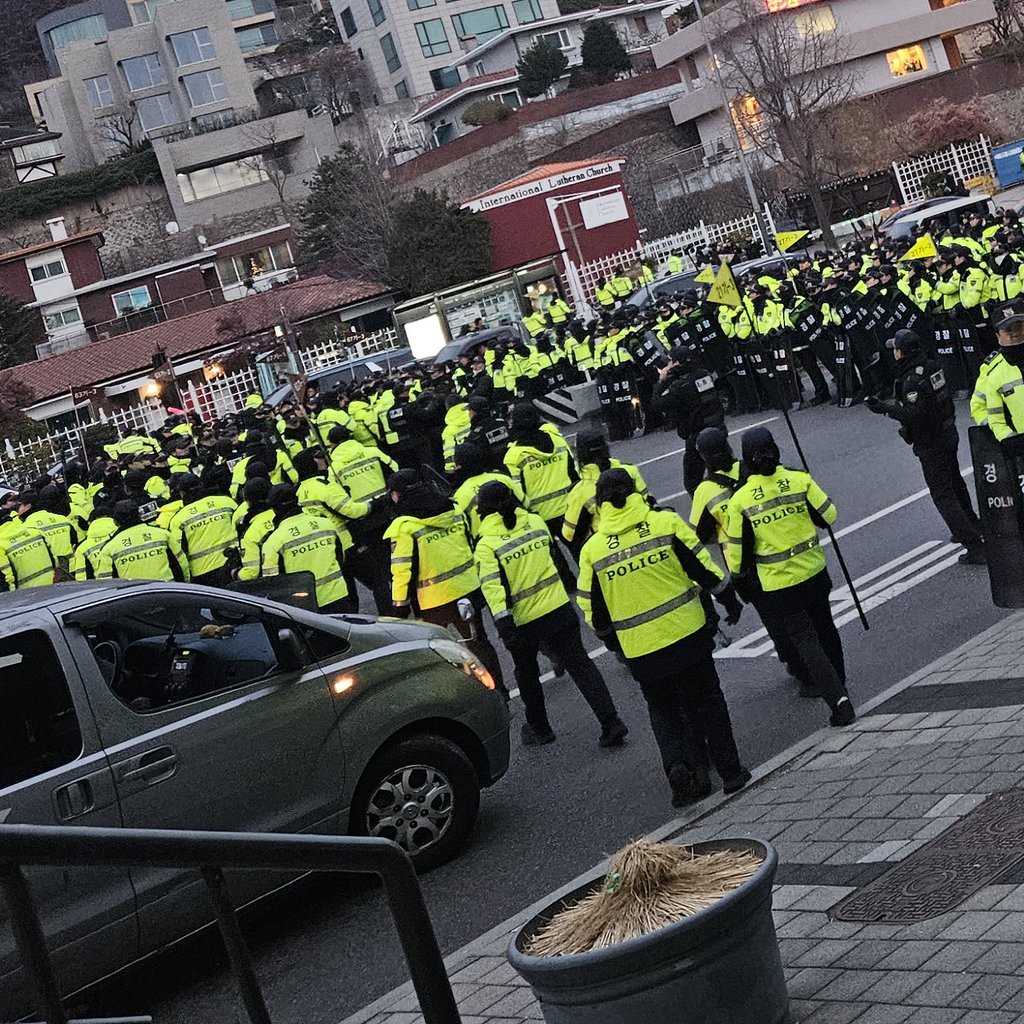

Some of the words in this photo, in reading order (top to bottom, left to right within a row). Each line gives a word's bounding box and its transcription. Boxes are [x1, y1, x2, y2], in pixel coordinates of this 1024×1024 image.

[480, 183, 543, 209] International
[548, 172, 586, 189] Lutheran
[586, 164, 614, 178] Church
[342, 464, 375, 481] POLICE
[529, 454, 564, 471] POLICE
[751, 478, 791, 501] 경찰
[190, 512, 227, 531] POLICE
[752, 504, 806, 528] POLICE
[289, 520, 319, 537] 경찰
[426, 521, 465, 544] POLICE
[605, 521, 651, 550] 경찰
[12, 541, 43, 557] POLICE
[121, 548, 164, 565] POLICE
[291, 537, 333, 557] POLICE
[504, 537, 549, 564] POLICE
[606, 550, 670, 581] POLICE
